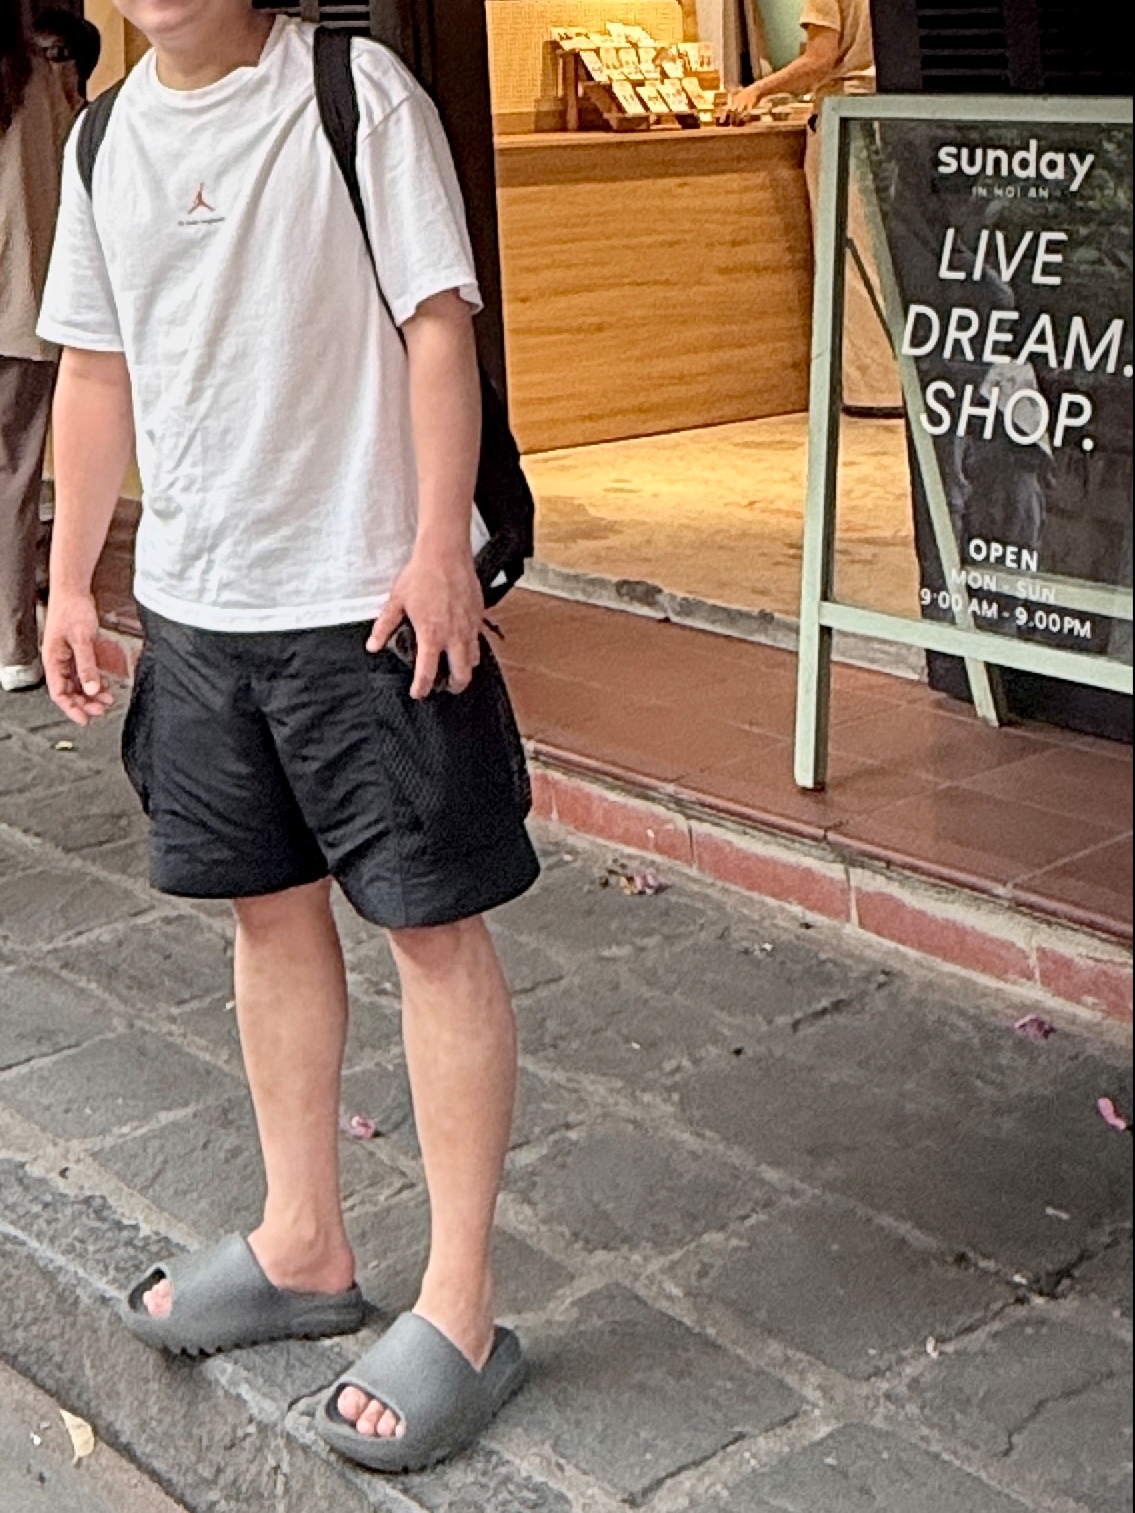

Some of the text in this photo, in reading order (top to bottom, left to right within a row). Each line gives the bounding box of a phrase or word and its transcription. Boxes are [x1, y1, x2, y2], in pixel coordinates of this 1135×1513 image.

[938, 139, 1094, 192] sunday
[938, 228, 1069, 285] LIVE
[901, 303, 1134, 377] DREAM.
[919, 380, 1095, 452] SHOP.
[969, 538, 1039, 572] OPEN
[951, 567, 997, 591] MON
[1016, 580, 1056, 602] SUN
[968, 598, 999, 619] AM
